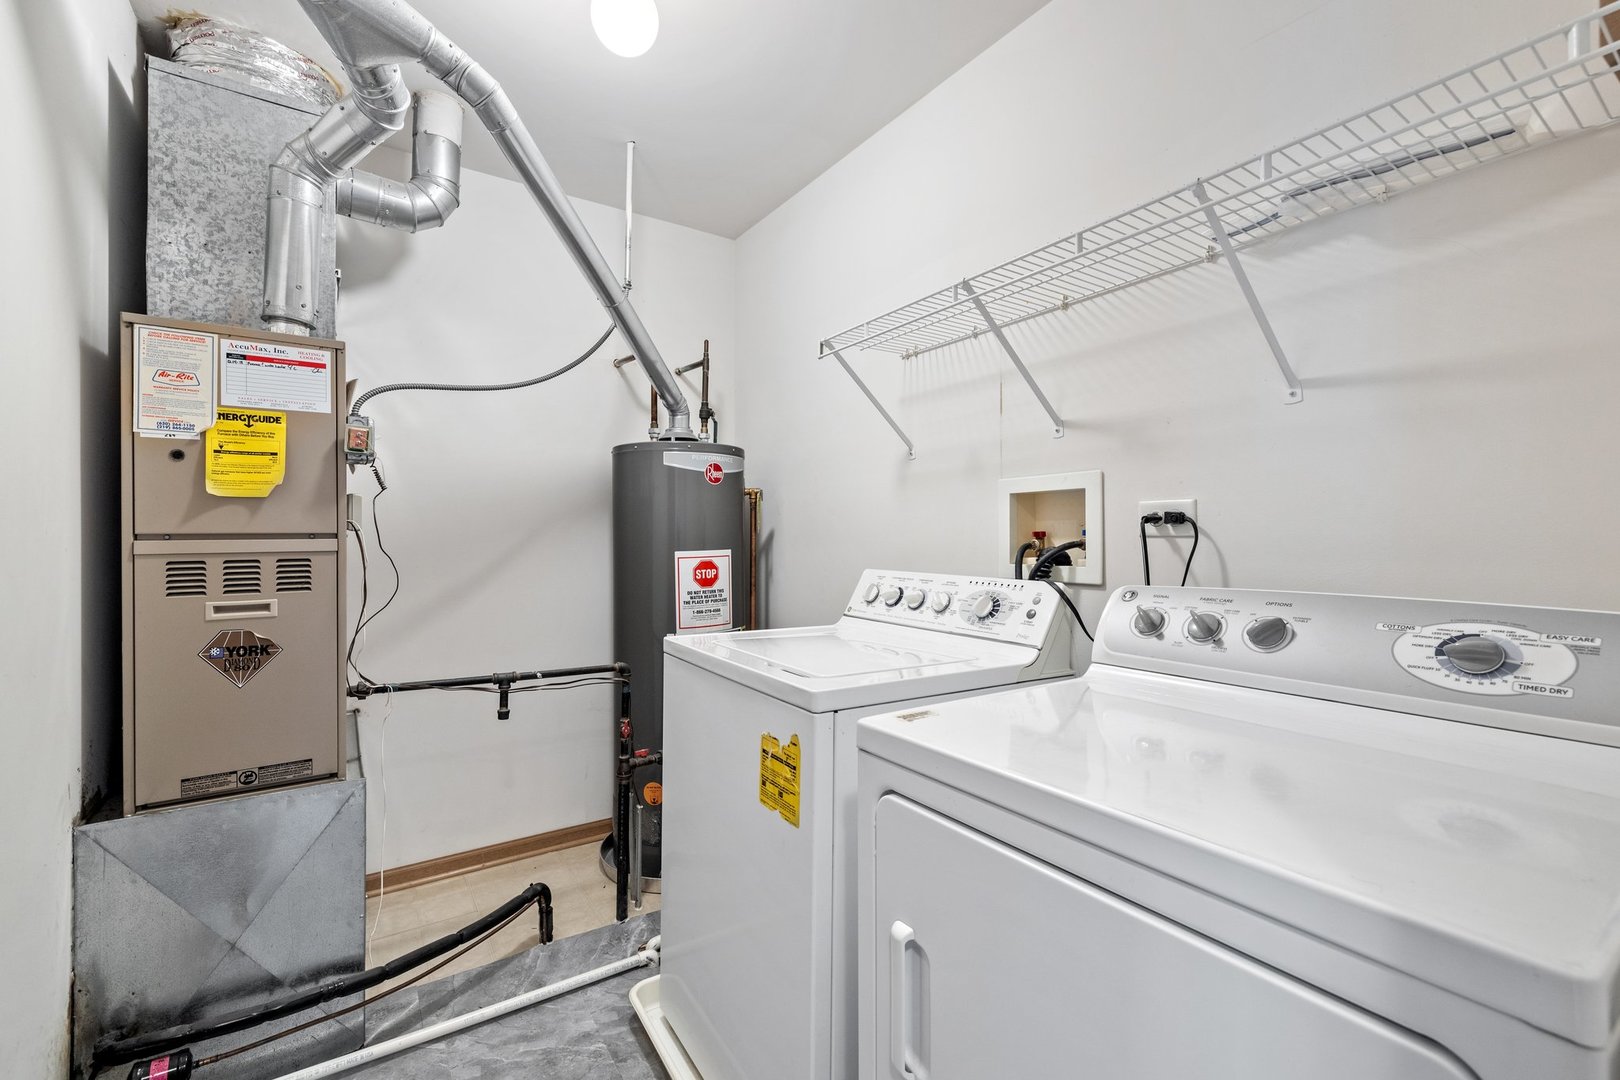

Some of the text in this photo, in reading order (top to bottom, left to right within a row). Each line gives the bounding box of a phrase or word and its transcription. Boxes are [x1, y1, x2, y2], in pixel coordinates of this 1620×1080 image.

[158, 370, 194, 380] Air-Rite
[695, 568, 717, 580] STOP
[1382, 623, 1416, 631] COTTONS
[225, 644, 271, 658] YORK
[1518, 684, 1547, 692] TIMED
